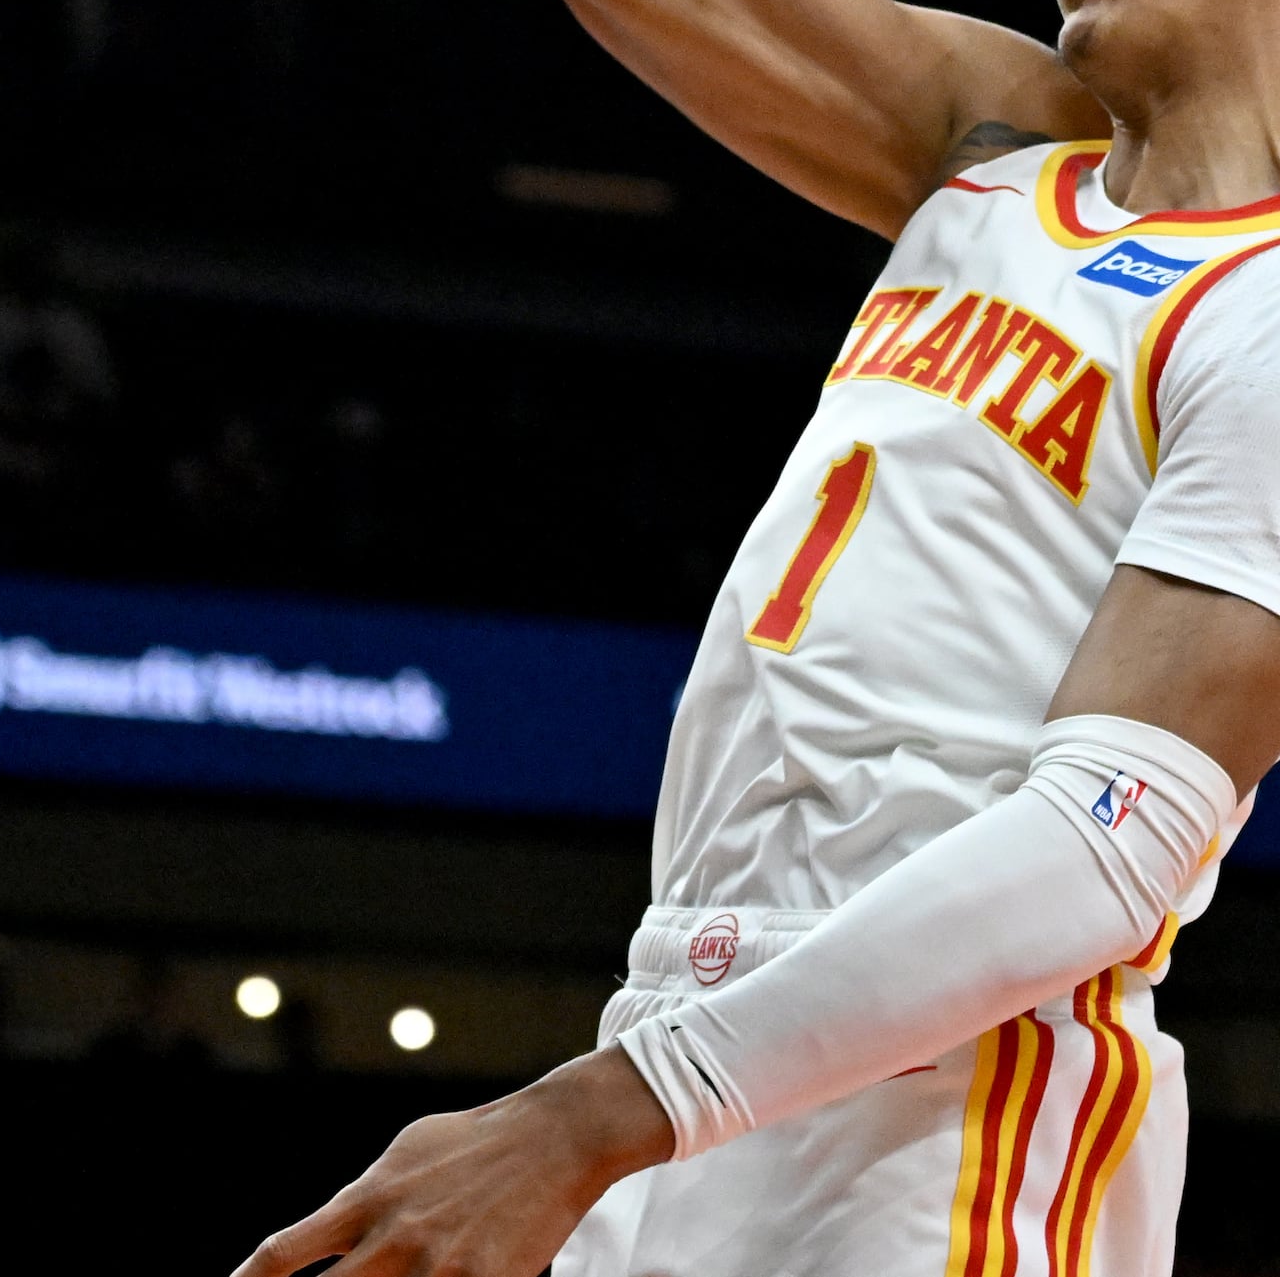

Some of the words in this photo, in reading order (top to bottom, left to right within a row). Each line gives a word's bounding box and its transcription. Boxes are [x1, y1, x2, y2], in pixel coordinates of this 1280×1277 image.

[1092, 252, 1185, 286] paze
[823, 286, 1114, 507] TLANTA
[743, 440, 878, 655] 1
[1095, 805, 1112, 822] NBA
[688, 936, 740, 960] HAWKS
